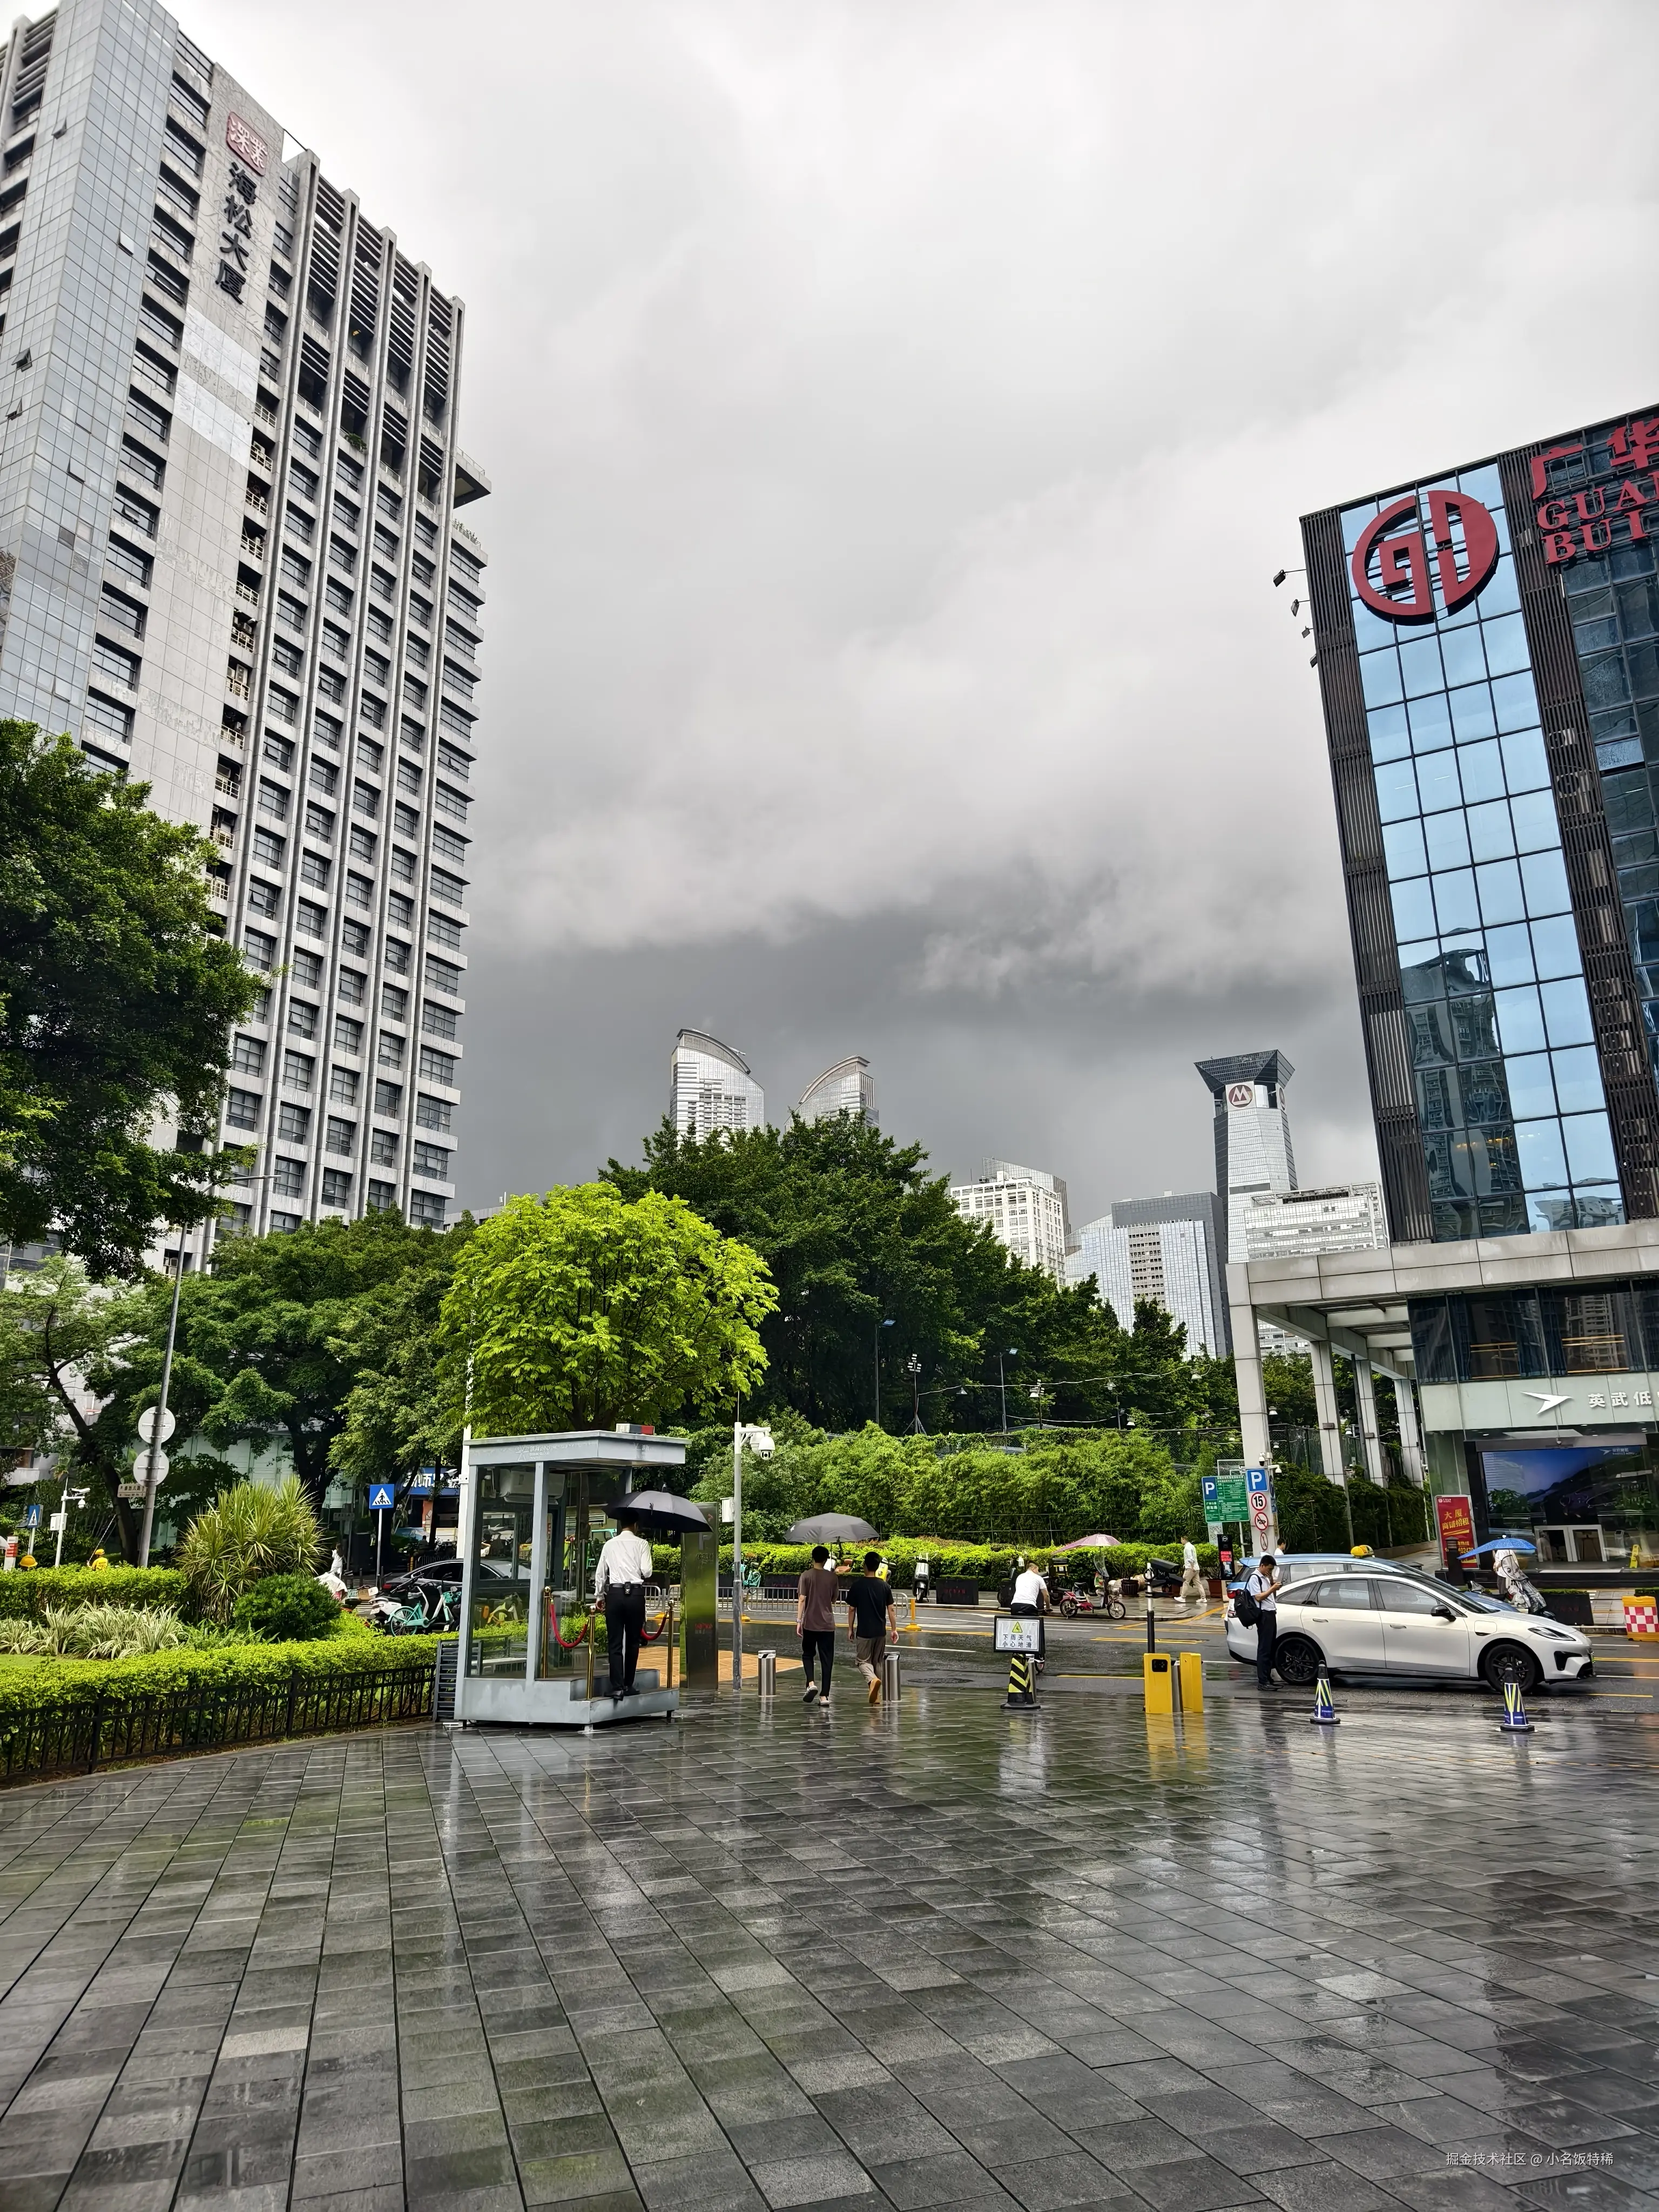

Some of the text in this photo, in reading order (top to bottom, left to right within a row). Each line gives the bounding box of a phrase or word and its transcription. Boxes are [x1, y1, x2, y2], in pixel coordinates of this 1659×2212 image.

[215, 161, 257, 305] 海松大厦
[1530, 417, 1659, 500] 广华
[1588, 1391, 1659, 1408] 英武低
[1205, 1482, 1215, 1495] P
[1251, 1472, 1262, 1489] P
[1253, 1495, 1263, 1507] 15
[1442, 1518, 1469, 1530] 商铺招租
